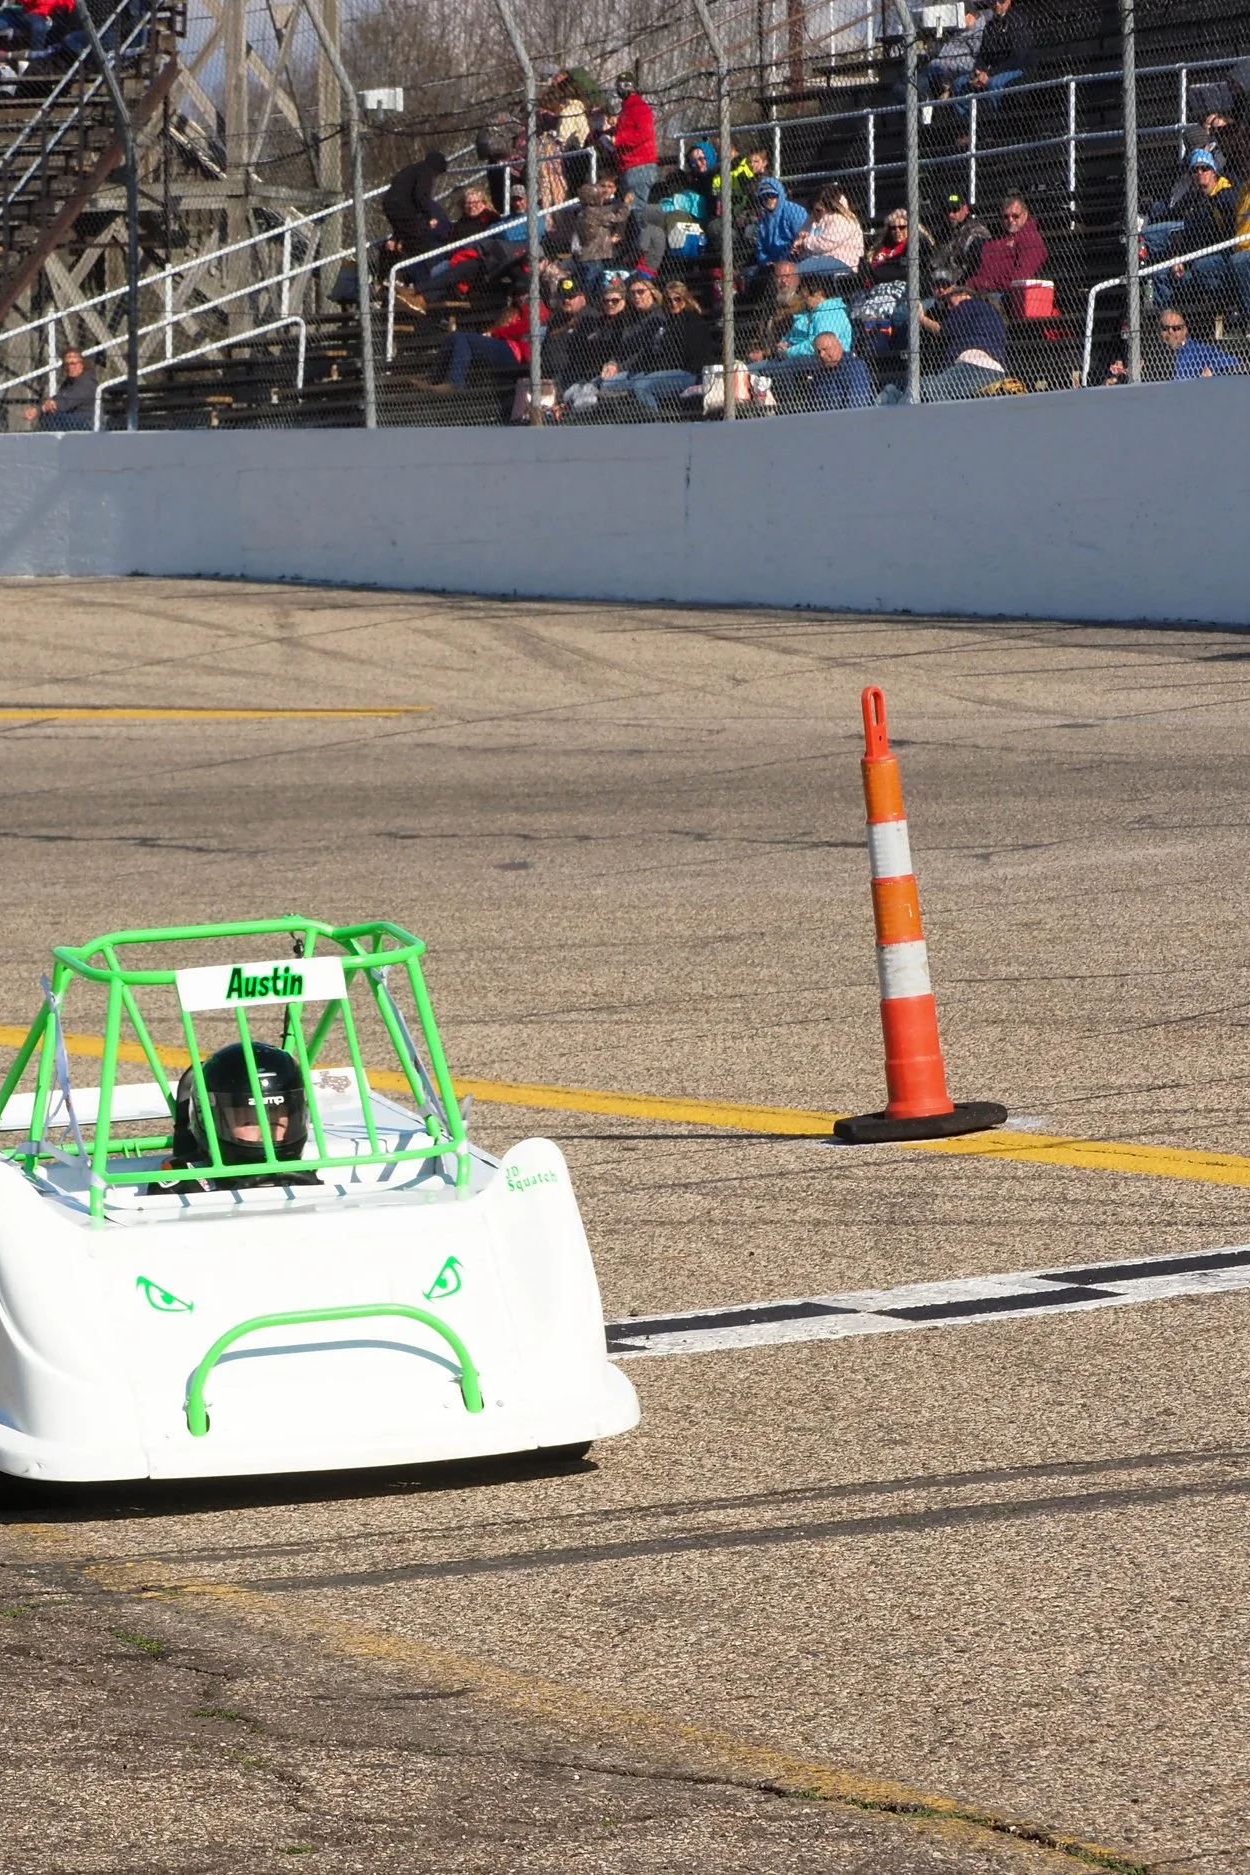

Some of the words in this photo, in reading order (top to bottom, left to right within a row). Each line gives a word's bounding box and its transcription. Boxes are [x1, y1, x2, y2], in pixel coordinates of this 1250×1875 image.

[225, 966, 303, 1000] Austin
[248, 1095, 285, 1106] zmp
[505, 1166, 519, 1179] JD
[507, 1169, 558, 1192] Squatch
